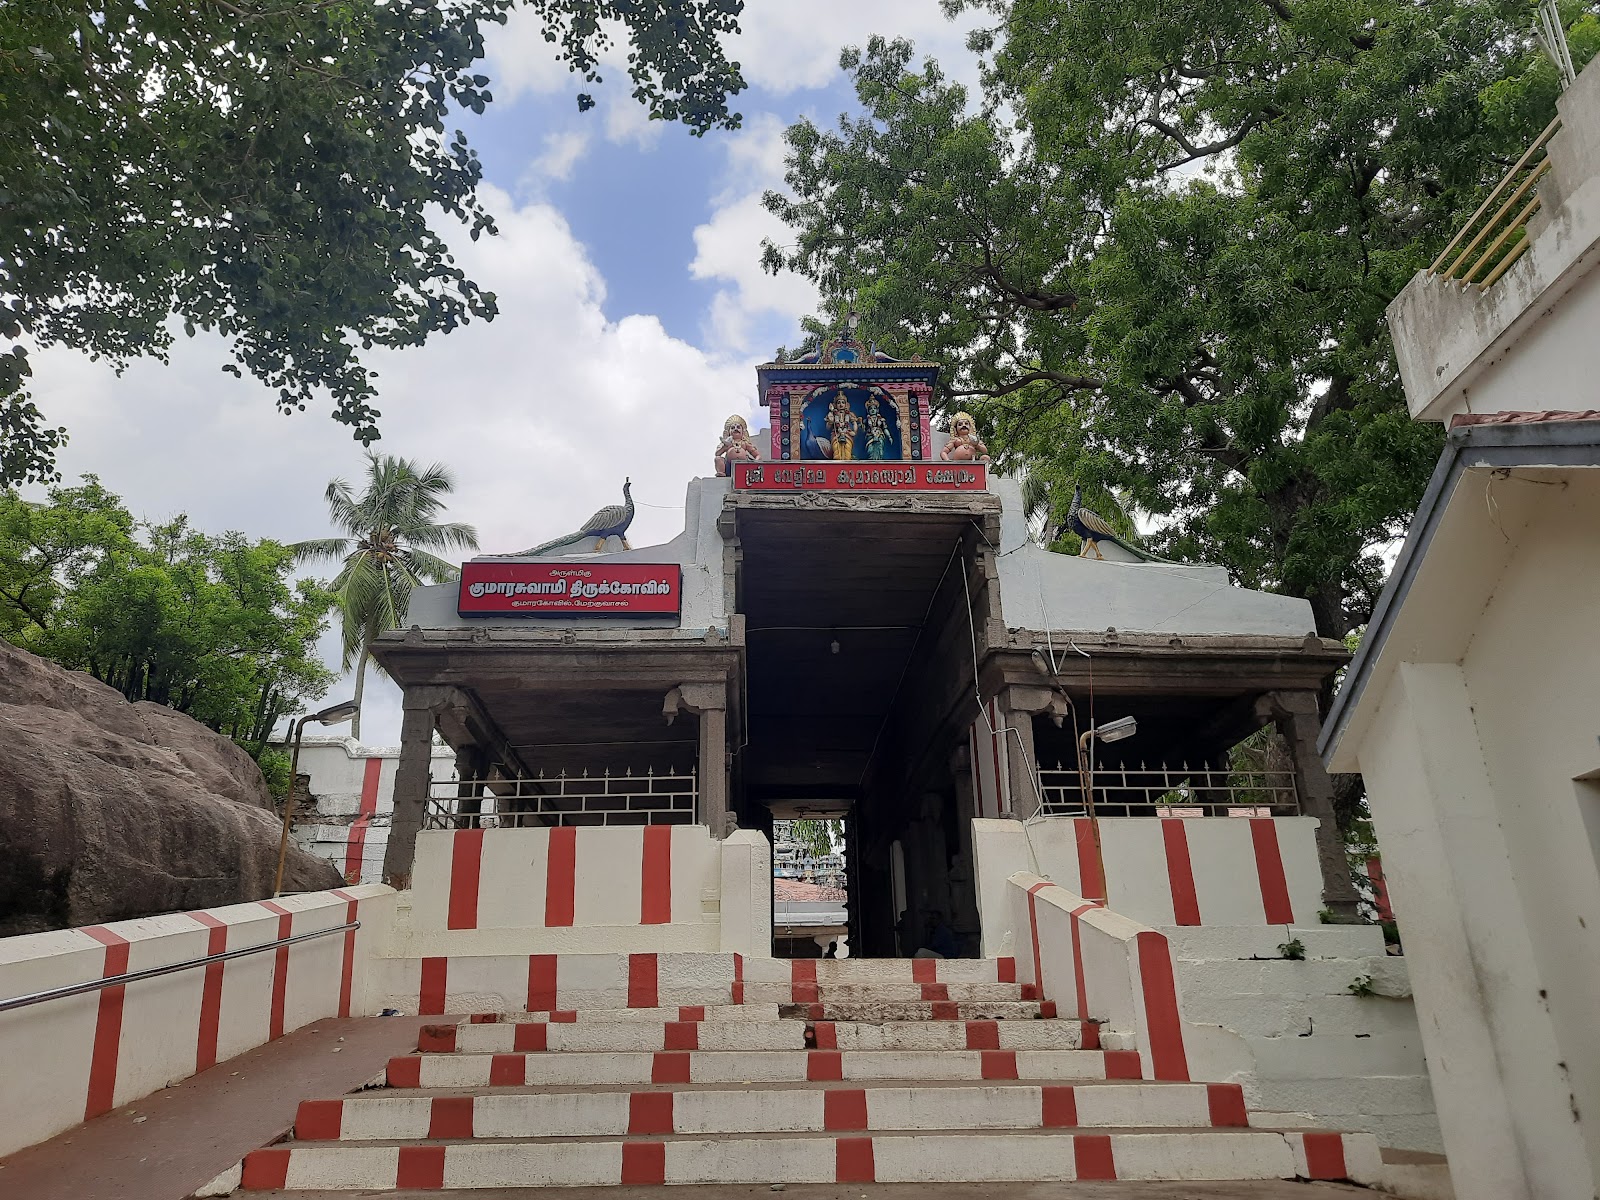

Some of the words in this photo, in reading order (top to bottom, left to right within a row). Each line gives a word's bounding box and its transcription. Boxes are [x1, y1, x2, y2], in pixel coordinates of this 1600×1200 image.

[837, 466, 917, 487] കുമാരസ്വാമി
[926, 469, 975, 487] ക്ഷേത്രം
[549, 569, 592, 577] அருள்மிகு
[469, 579, 566, 597] குமாரசுவாமி
[570, 579, 670, 597] திருக்கோவில்
